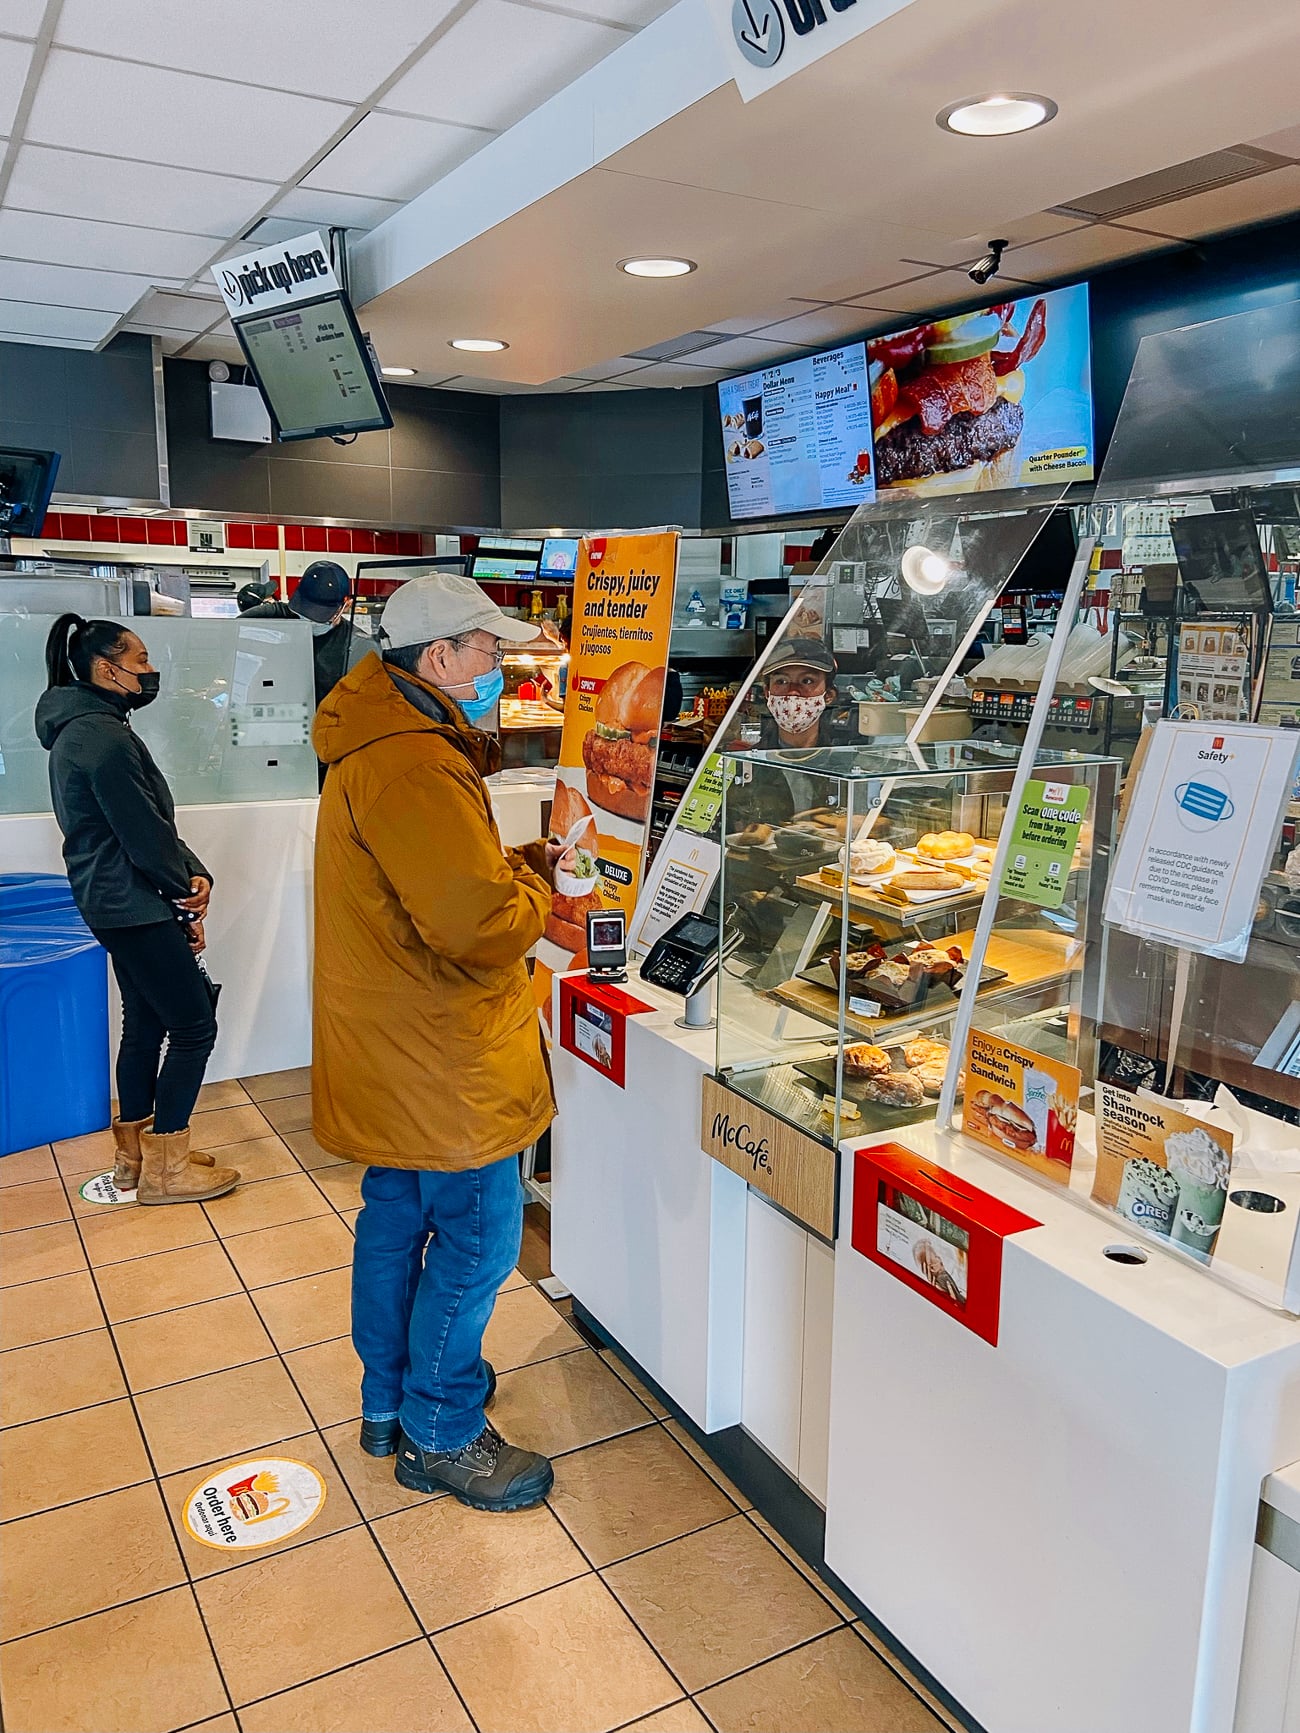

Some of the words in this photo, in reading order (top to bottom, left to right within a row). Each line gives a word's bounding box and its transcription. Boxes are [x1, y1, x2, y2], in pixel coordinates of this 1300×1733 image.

[238, 261, 272, 304] pick
[270, 261, 293, 293] up
[284, 250, 328, 283] here
[812, 352, 843, 365] Beverages
[763, 380, 779, 390] Dollar
[780, 377, 794, 386] Menu
[815, 390, 834, 400] Happy
[1029, 455, 1052, 463] Quarter
[1043, 462, 1065, 471] Cheese
[588, 570, 625, 596] Crispy,
[626, 569, 660, 596] juicy
[584, 598, 606, 617] and
[607, 599, 648, 618] tender
[582, 625, 618, 640] Crujientes,
[620, 626, 653, 641] tiernitos
[580, 643, 585, 655] y
[584, 640, 612, 656] jugosos
[581, 680, 596, 690] SPICY
[580, 694, 591, 704] Crispy
[578, 704, 594, 712] Chicken
[1023, 804, 1039, 816] Scan
[1040, 807, 1058, 820] one
[1057, 808, 1080, 824] code
[1029, 819, 1043, 829] from
[1044, 822, 1053, 831] the
[1054, 826, 1066, 836] app
[1022, 830, 1041, 841] before
[1041, 835, 1067, 849] ordering
[1148, 856, 1174, 866] released
[1176, 860, 1191, 870] CDC
[1191, 865, 1224, 877] guidance,
[1155, 849, 1193, 860] accordance
[1209, 859, 1231, 870] newly
[605, 865, 628, 881] DELUXE
[1182, 873, 1210, 883] increase
[604, 880, 617, 892] Crispy
[1148, 874, 1169, 884] COVID
[1170, 880, 1190, 890] cases,
[1191, 885, 1214, 894] please
[603, 889, 621, 902] Chicken
[1139, 882, 1172, 894] remember
[1204, 896, 1219, 906] face
[1147, 894, 1164, 902] mask
[1165, 898, 1183, 907] when
[1184, 901, 1205, 912] inside
[972, 1036, 996, 1056] Enjoy
[997, 1048, 1002, 1056] a
[971, 1050, 1009, 1072] Chicken
[971, 1063, 1016, 1090] Sandwich
[1026, 1088, 1045, 1099] Sprite
[1103, 1086, 1115, 1096] Get
[1116, 1091, 1131, 1102] into
[1103, 1095, 1165, 1129] Shamrock
[1103, 1108, 1146, 1132] season
[1132, 1200, 1169, 1221] OREO
[204, 1487, 225, 1517] Order
[217, 1515, 237, 1544] here
